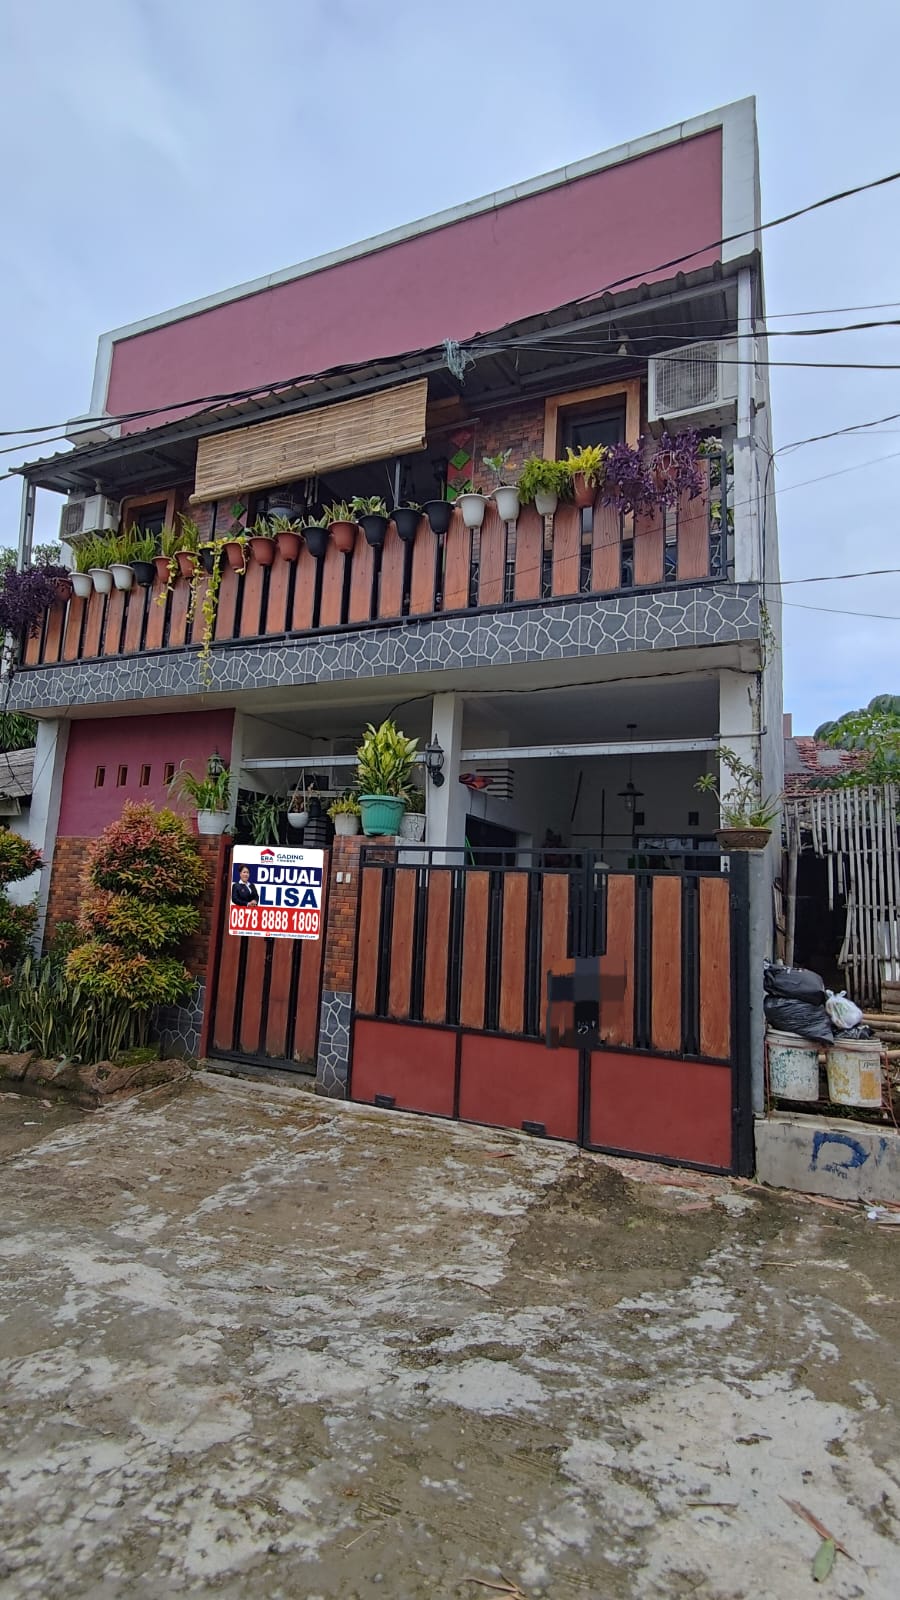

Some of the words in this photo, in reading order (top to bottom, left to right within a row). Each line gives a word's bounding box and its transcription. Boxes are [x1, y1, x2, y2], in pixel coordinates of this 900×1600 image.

[276, 853, 304, 861] GADING
[257, 866, 320, 886] DIJUAL
[259, 886, 318, 908] LISA
[231, 908, 258, 929] 0878
[261, 910, 288, 931] 8888
[292, 911, 319, 932] 1809
